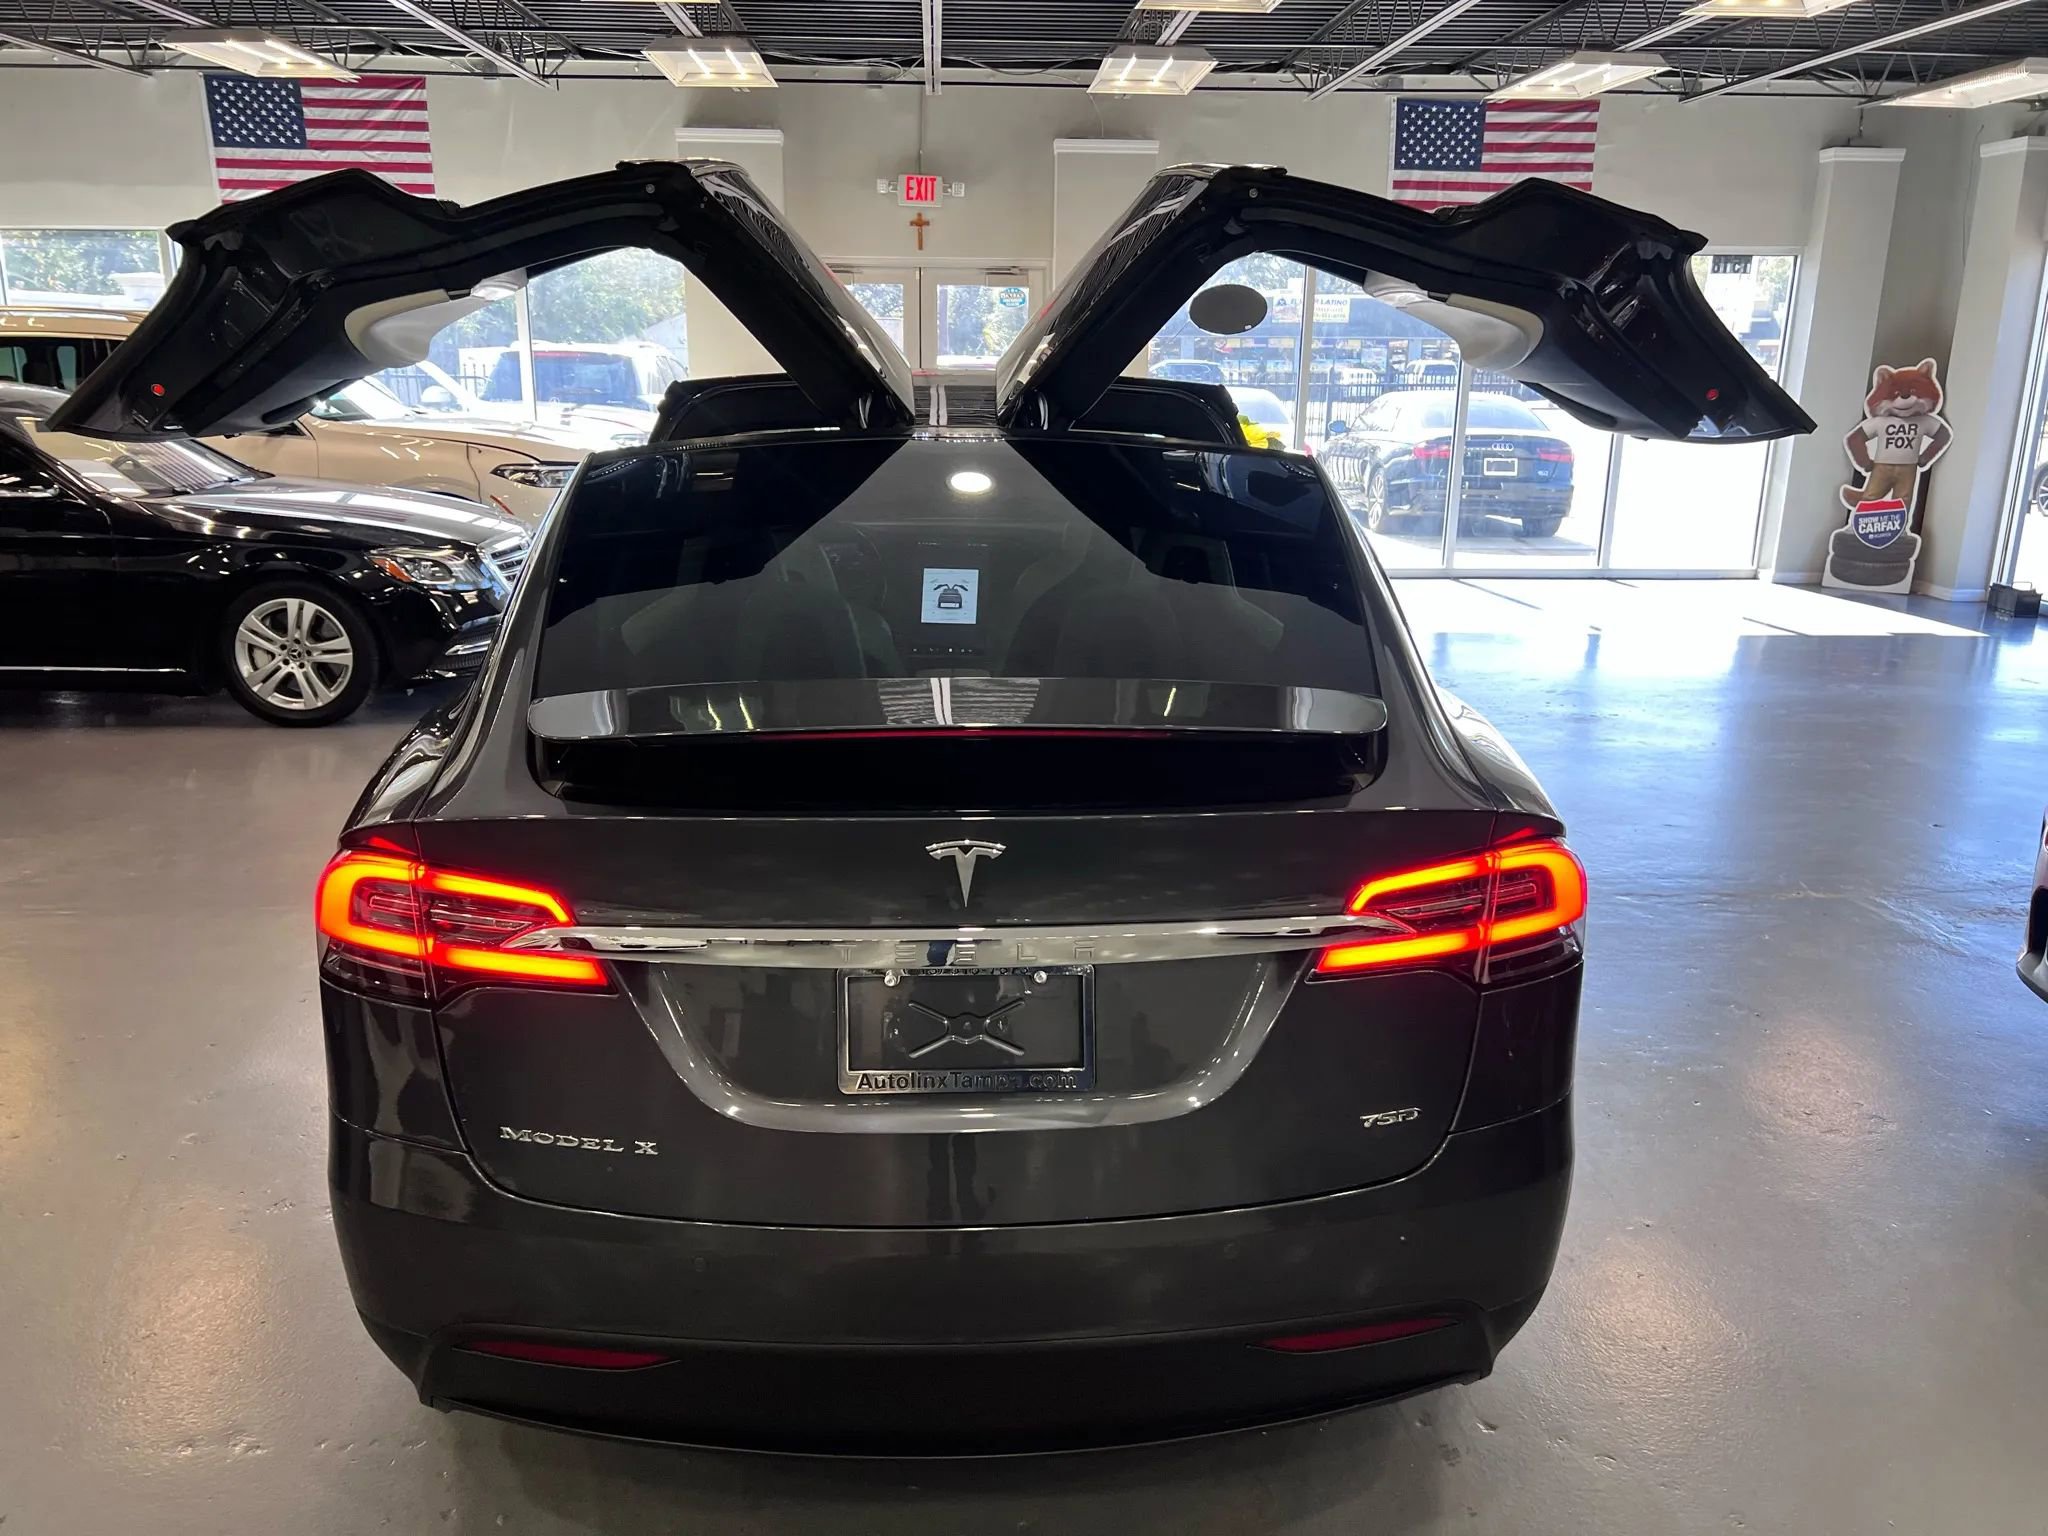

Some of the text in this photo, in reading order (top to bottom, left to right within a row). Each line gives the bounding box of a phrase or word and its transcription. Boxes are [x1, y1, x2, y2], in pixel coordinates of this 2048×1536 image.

[905, 175, 937, 202] EXIT
[1885, 423, 1918, 436] CAR
[1885, 436, 1915, 449] FOX
[1858, 516, 1879, 524] SHOW
[1858, 520, 1901, 534] CARFAX
[832, 942, 1096, 964] TESLA
[1359, 1107, 1422, 1128] 75D
[500, 1126, 659, 1155] MODEL X
